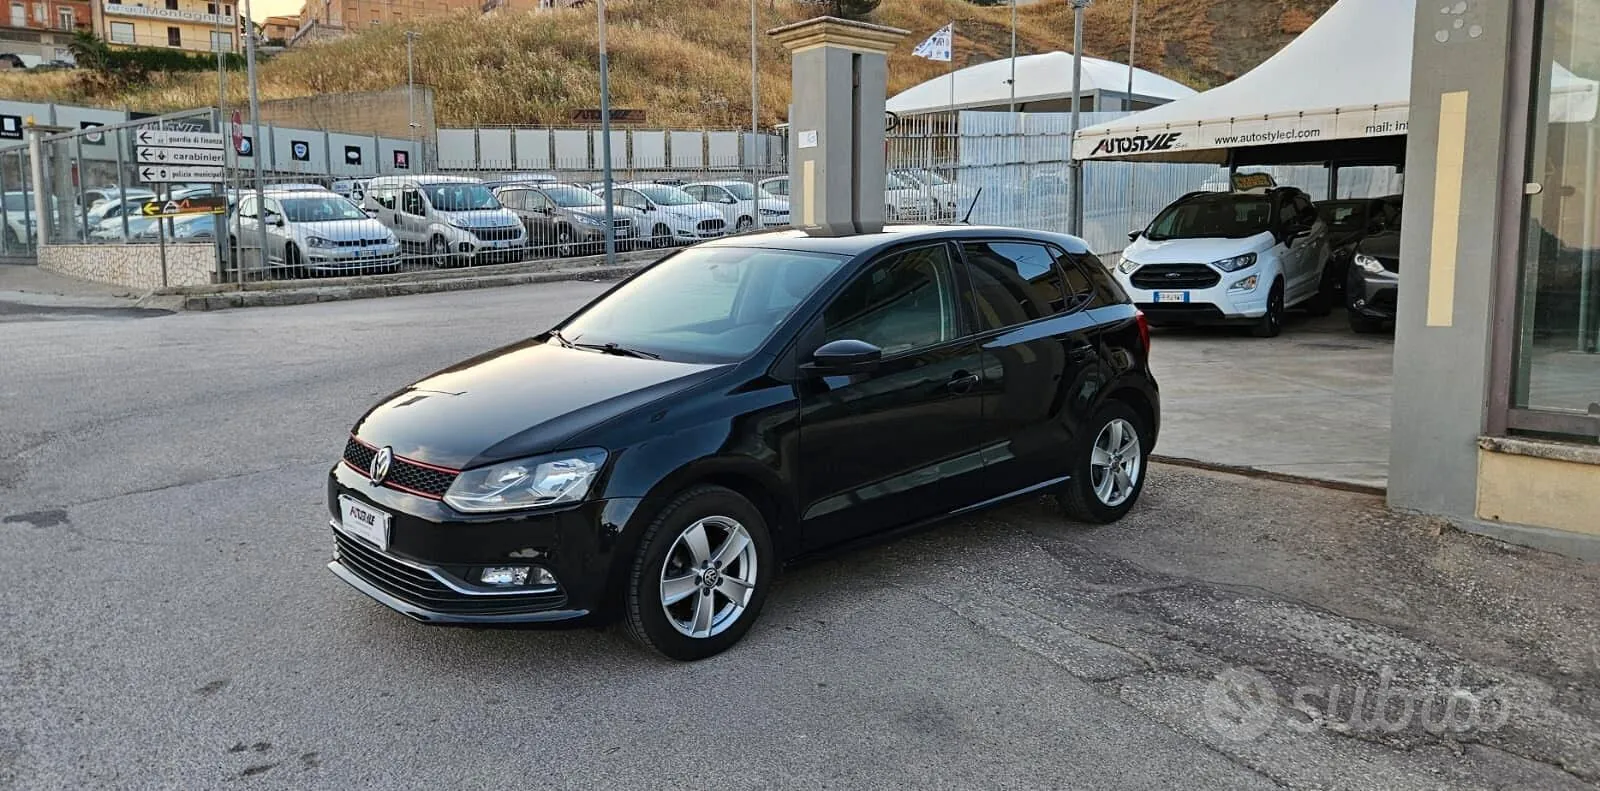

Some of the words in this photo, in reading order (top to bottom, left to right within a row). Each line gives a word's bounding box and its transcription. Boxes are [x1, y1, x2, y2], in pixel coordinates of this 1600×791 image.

[1366, 121, 1392, 133] mail:
[1090, 132, 1182, 155] AUTOSTYLE
[1214, 128, 1320, 145] www.autostylecl.com
[173, 152, 224, 161] carabinieri
